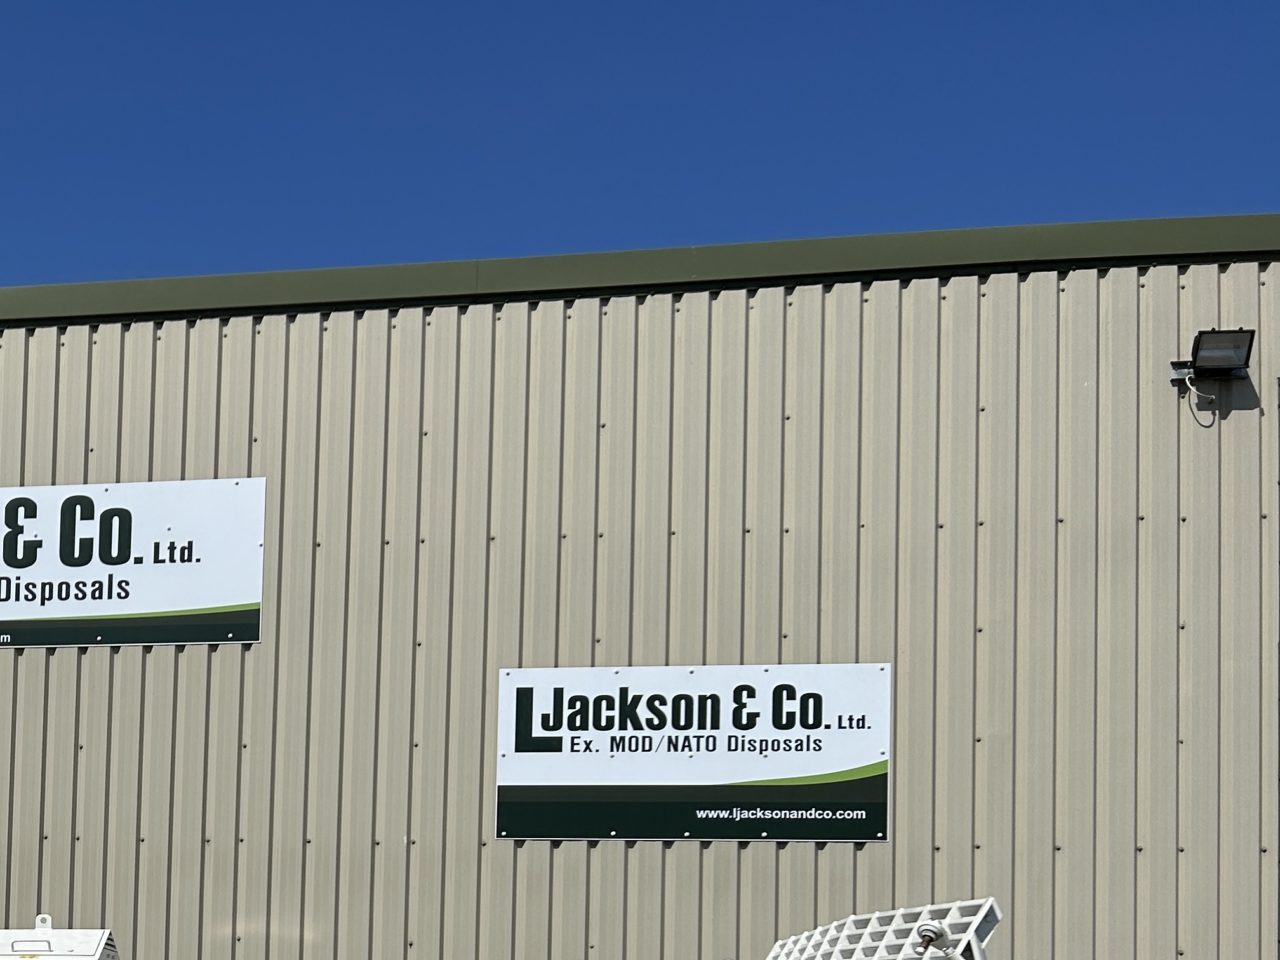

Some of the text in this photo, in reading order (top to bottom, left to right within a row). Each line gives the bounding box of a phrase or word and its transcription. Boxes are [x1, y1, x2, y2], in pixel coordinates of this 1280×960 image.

[2, 497, 43, 570] &
[59, 494, 144, 568] Co.
[153, 540, 202, 564] Ltd.
[731, 684, 761, 731] &
[771, 683, 832, 731] Co.
[837, 714, 872, 730] Ltd.
[570, 734, 823, 755] Ex. MOD/NATO Disposals
[695, 807, 867, 822] www.ljacksonandco.com
